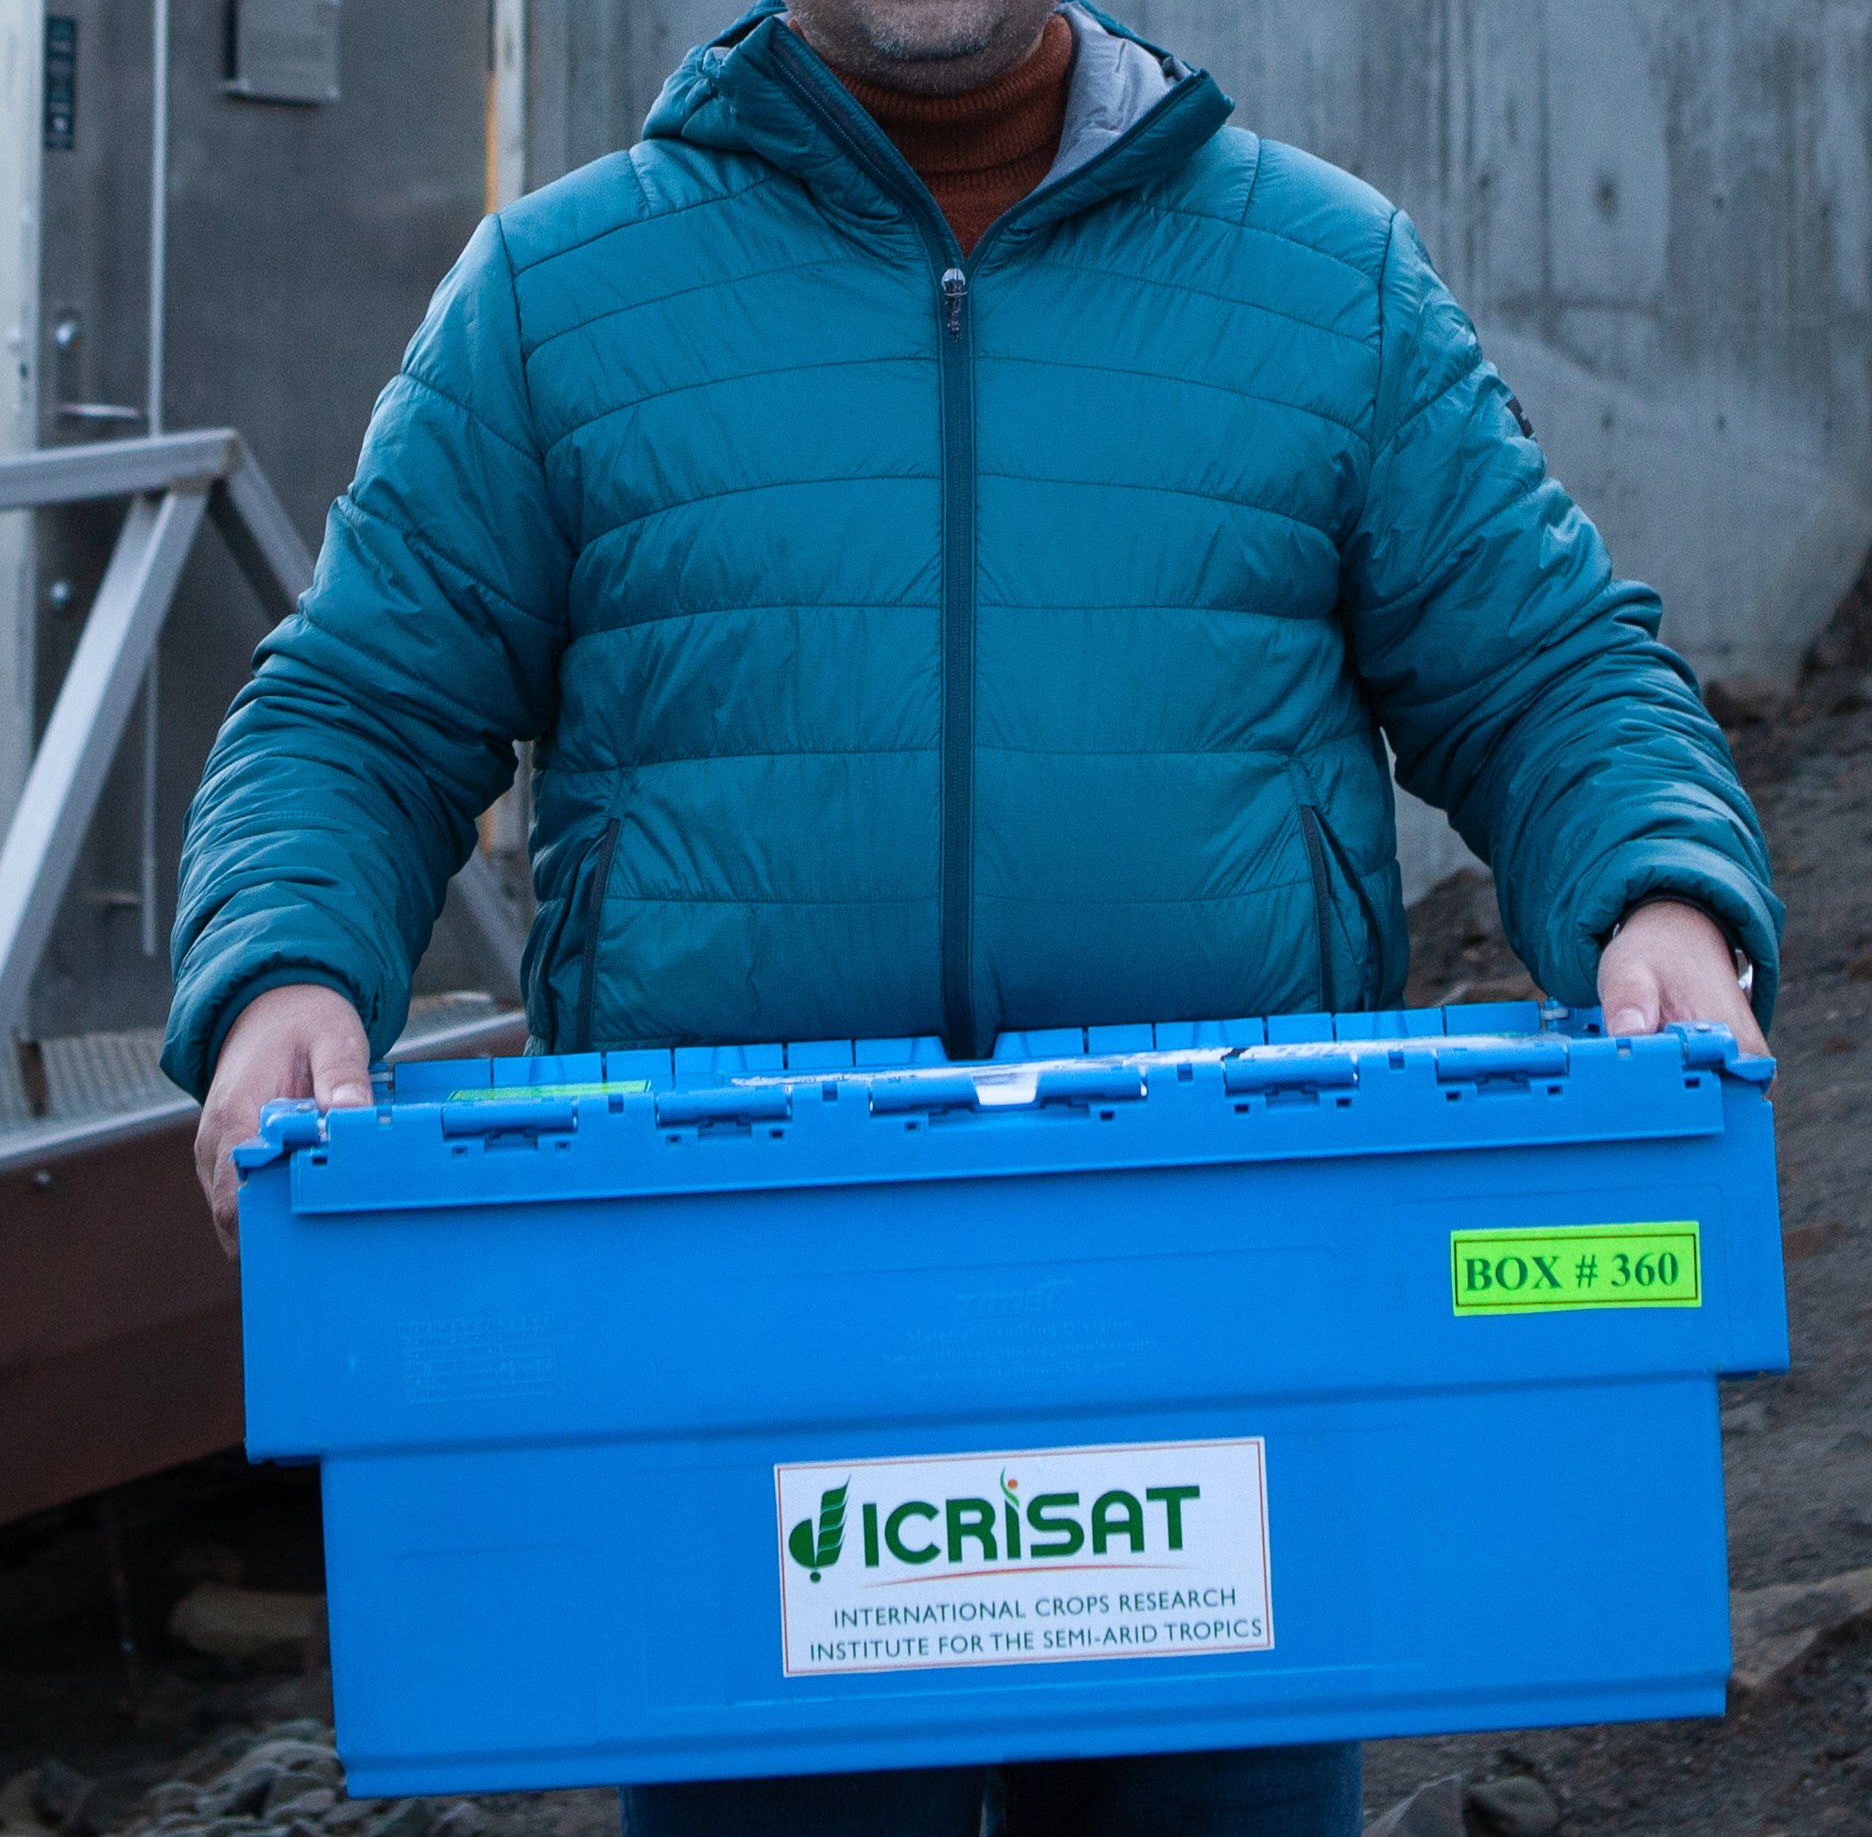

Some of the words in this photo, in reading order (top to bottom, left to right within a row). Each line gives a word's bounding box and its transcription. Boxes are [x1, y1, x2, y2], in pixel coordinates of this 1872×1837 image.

[1464, 1255, 1563, 1292] BOX
[1575, 1254, 1599, 1289] #
[1610, 1252, 1680, 1288] 360
[863, 1466, 1201, 1569] ICRISAT
[834, 1601, 1026, 1629] INTERNATIONAL
[1034, 1594, 1111, 1617] CROPS
[1119, 1588, 1236, 1613] RESEARCH
[810, 1636, 929, 1662] INSTITUTE
[938, 1634, 984, 1655] FOR
[990, 1631, 1034, 1651] THE
[1043, 1623, 1158, 1649] SEMI-ARID
[1164, 1618, 1263, 1641] TROPICS
